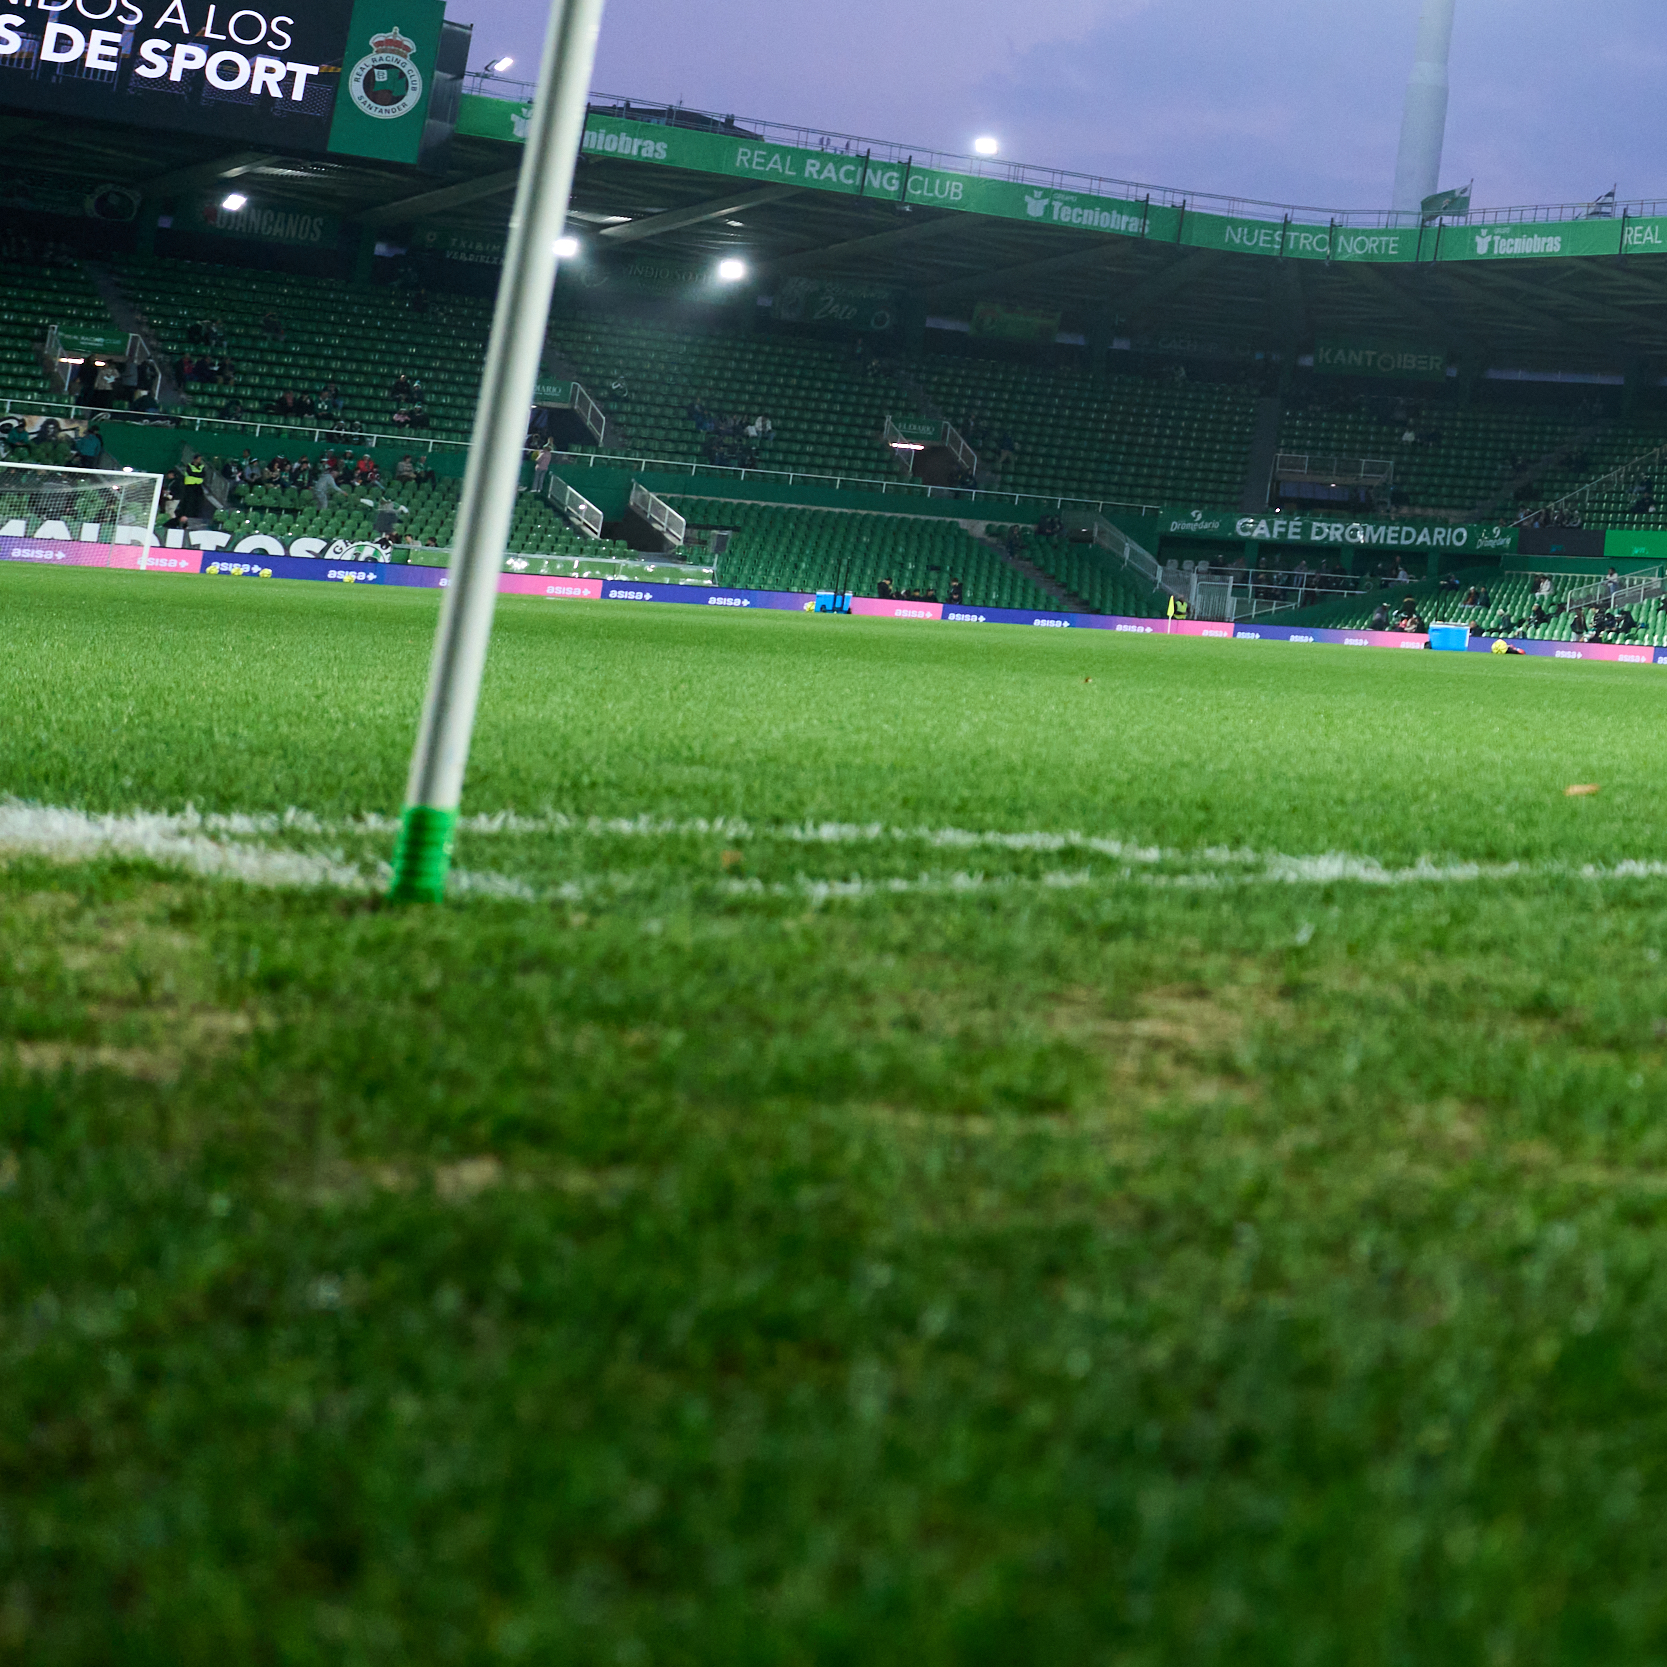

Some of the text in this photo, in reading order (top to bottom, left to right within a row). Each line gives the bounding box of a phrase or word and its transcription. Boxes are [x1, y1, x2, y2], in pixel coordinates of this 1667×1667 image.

[204, 4, 294, 51] LOS
[0, 14, 319, 101] S DE SPORT
[353, 55, 418, 92] REAL RACING CLUB
[357, 95, 409, 114] SANTANDER
[582, 129, 668, 160] niobras
[736, 147, 965, 201] REAL RACING CLUB
[1052, 201, 1150, 234] Tecniobras
[1225, 226, 1400, 254] NUESTRO NORTE
[1493, 234, 1561, 254] Tecniobras
[1623, 225, 1661, 245] REAL
[1170, 519, 1220, 532] Dromedario
[1236, 517, 1468, 547] CAFÉ DROMEDARIO
